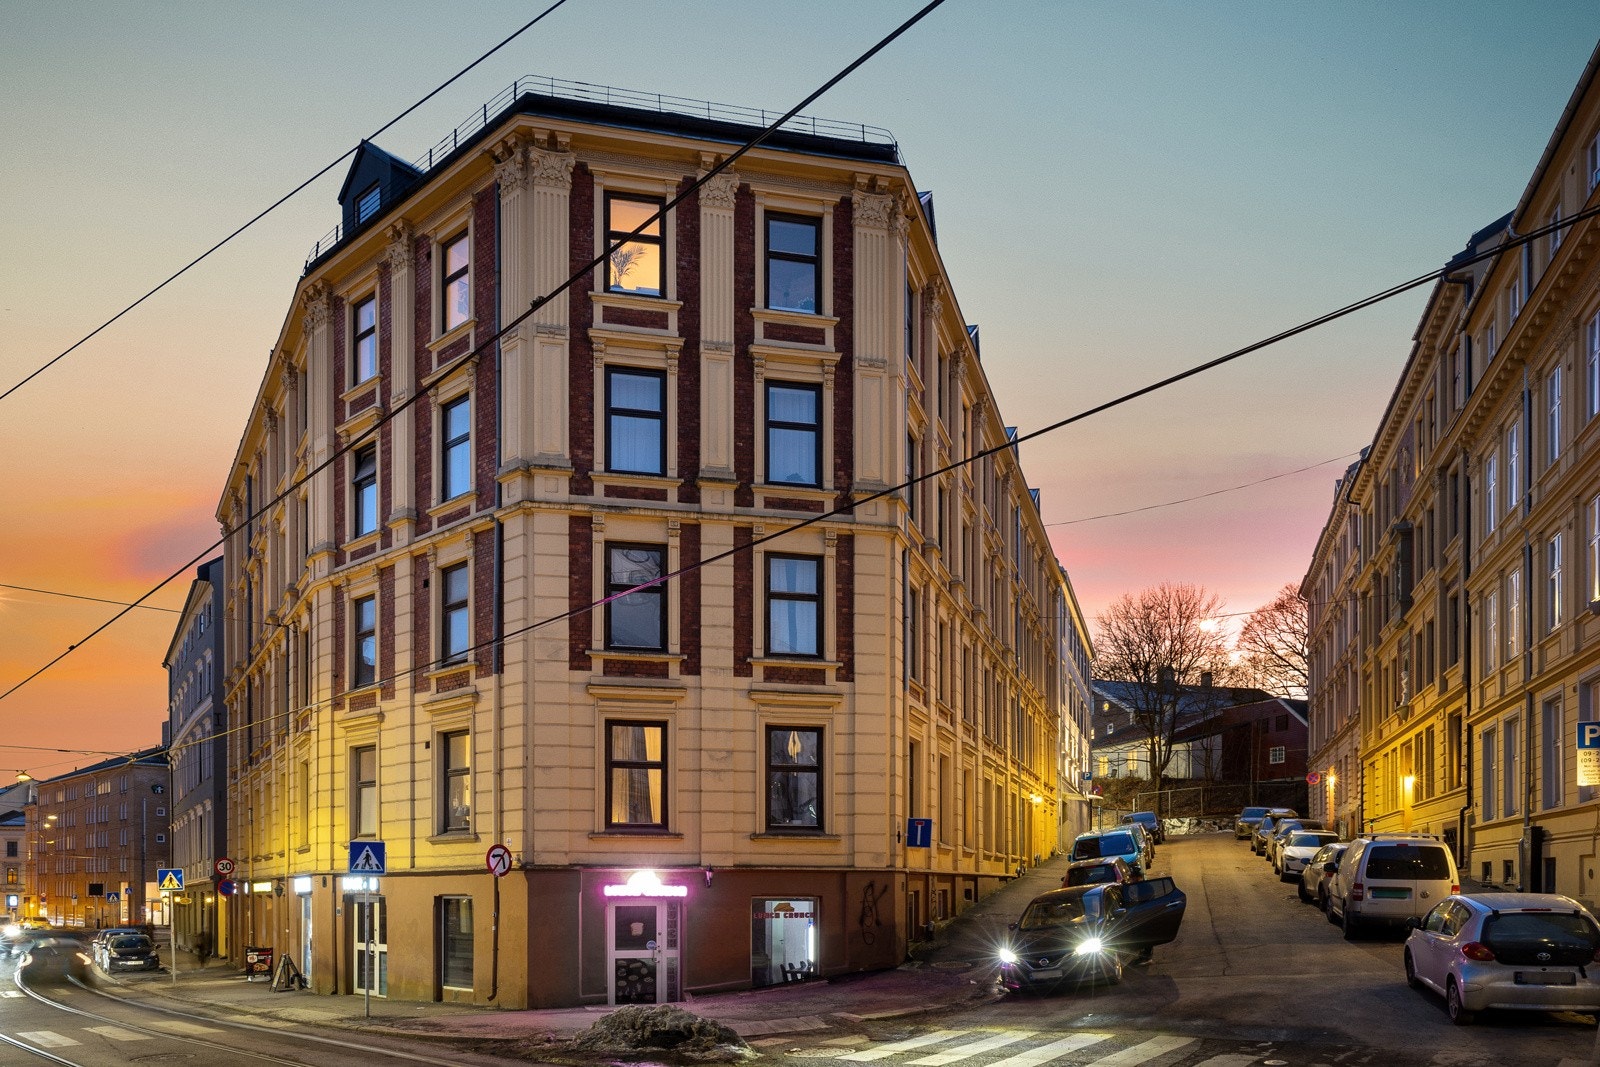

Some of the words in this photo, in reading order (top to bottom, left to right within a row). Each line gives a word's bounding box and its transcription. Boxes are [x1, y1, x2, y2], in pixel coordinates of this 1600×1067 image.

[1584, 725, 1600, 746] P
[1085, 772, 1091, 780] P
[219, 862, 232, 871] 30
